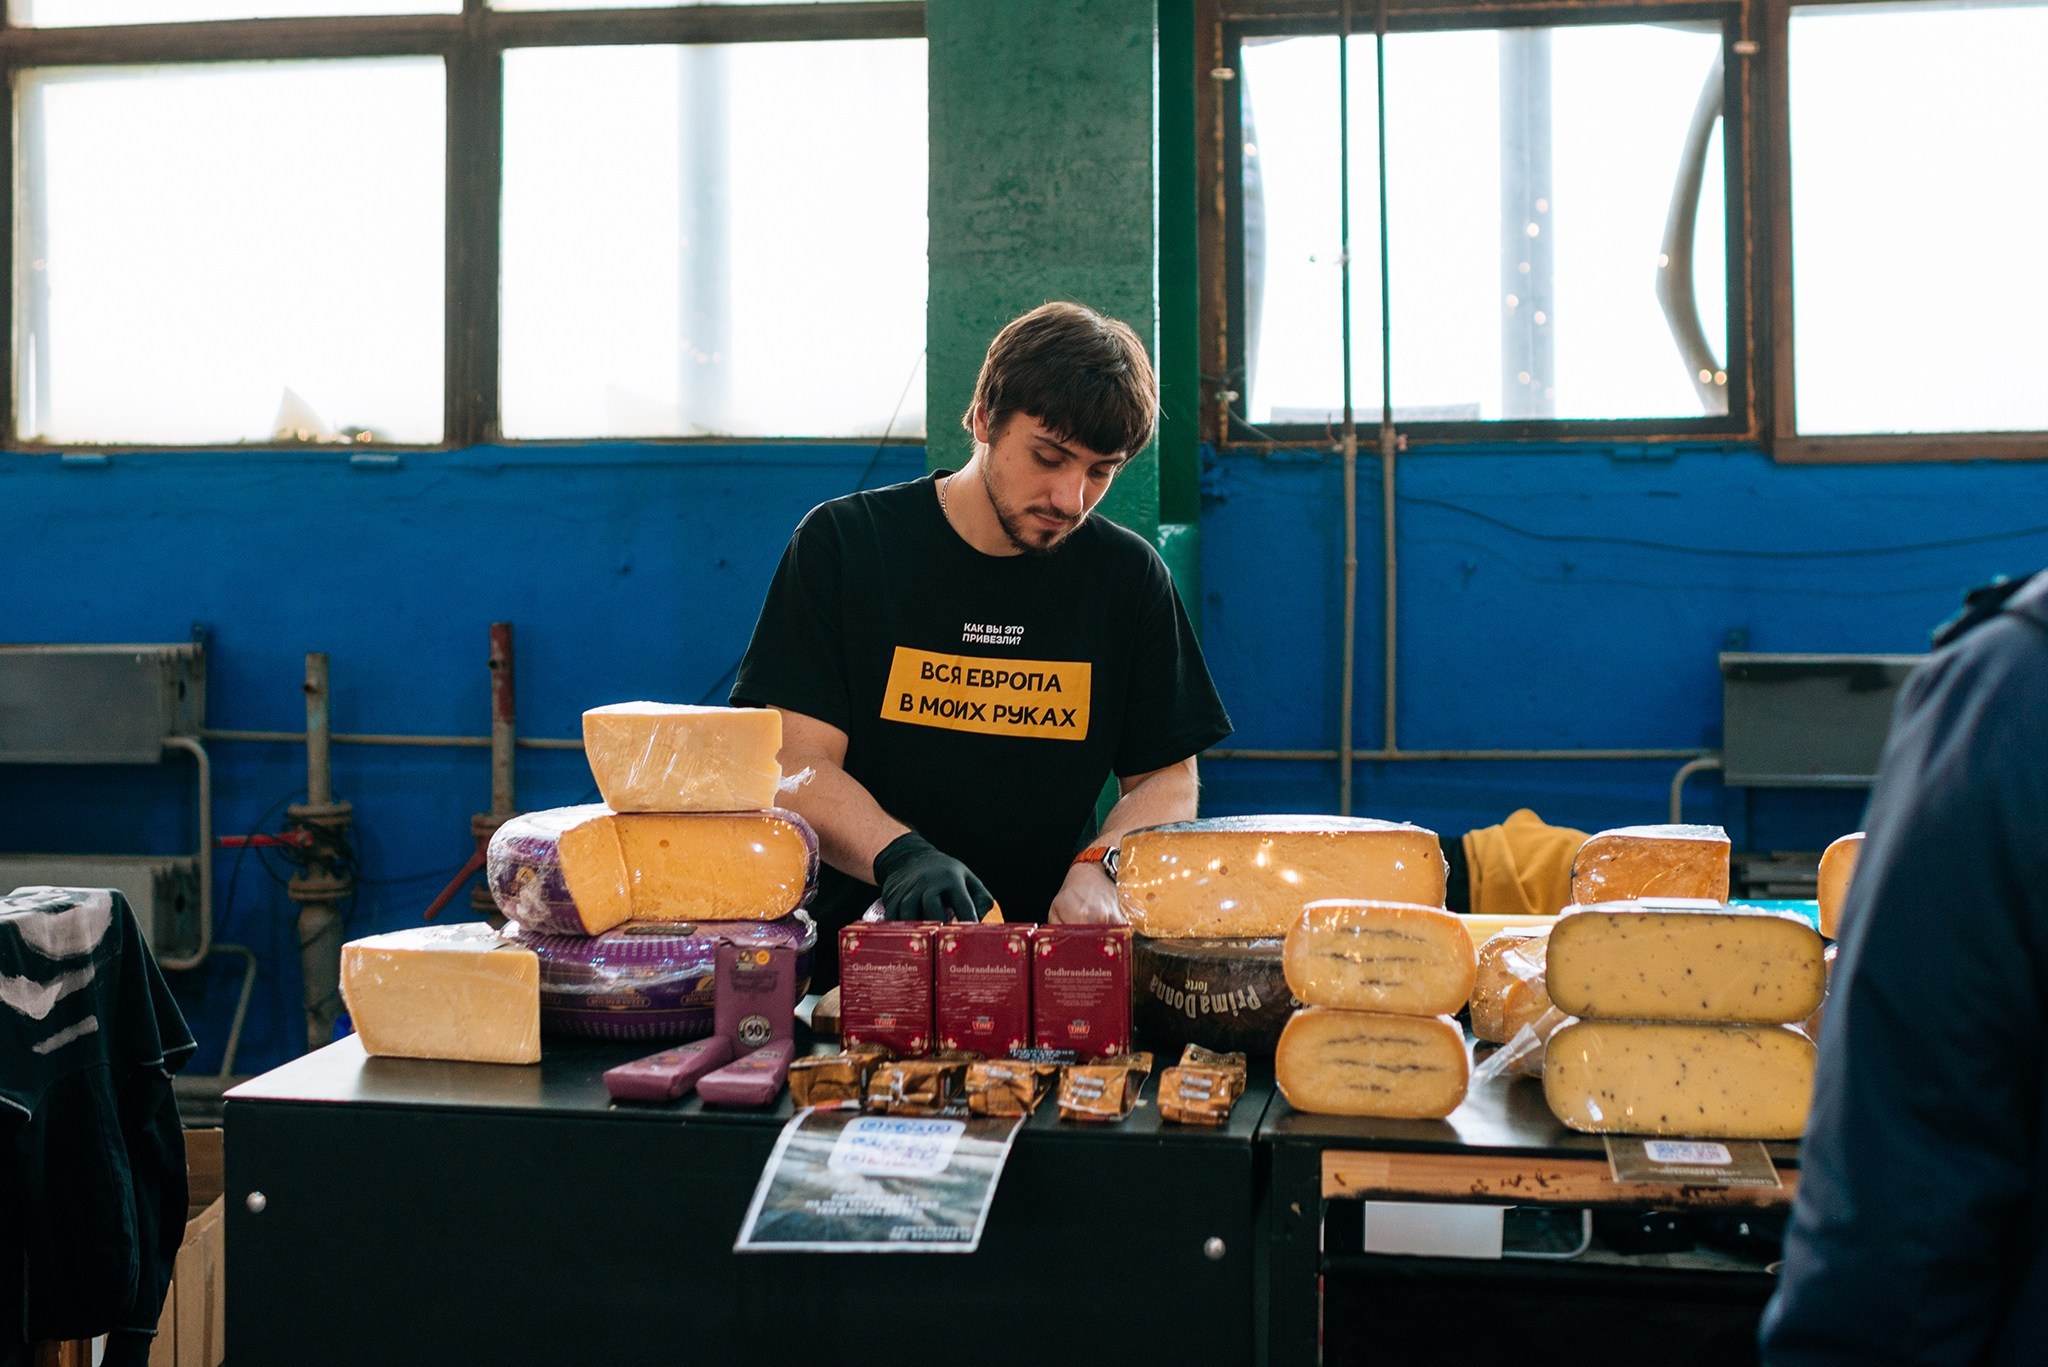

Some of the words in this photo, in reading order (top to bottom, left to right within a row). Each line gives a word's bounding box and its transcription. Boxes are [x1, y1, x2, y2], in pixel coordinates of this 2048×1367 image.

[963, 622, 984, 633] КАК
[986, 624, 1002, 634] ВЫ
[1004, 625, 1024, 635] ЭТО
[962, 633, 1021, 645] ПРИВЕЗЛИ?
[921, 661, 961, 685] ВСЯ
[966, 668, 1062, 692] ЕВРОПА
[899, 693, 914, 712] В
[919, 696, 986, 722] МОИХ
[993, 704, 1077, 728] РУКАХ
[949, 964, 1017, 974] Gudbrandsdalen
[1044, 967, 1112, 977] Gudbrandsdalen
[1184, 979, 1208, 994] forte
[746, 1024, 762, 1037] 50
